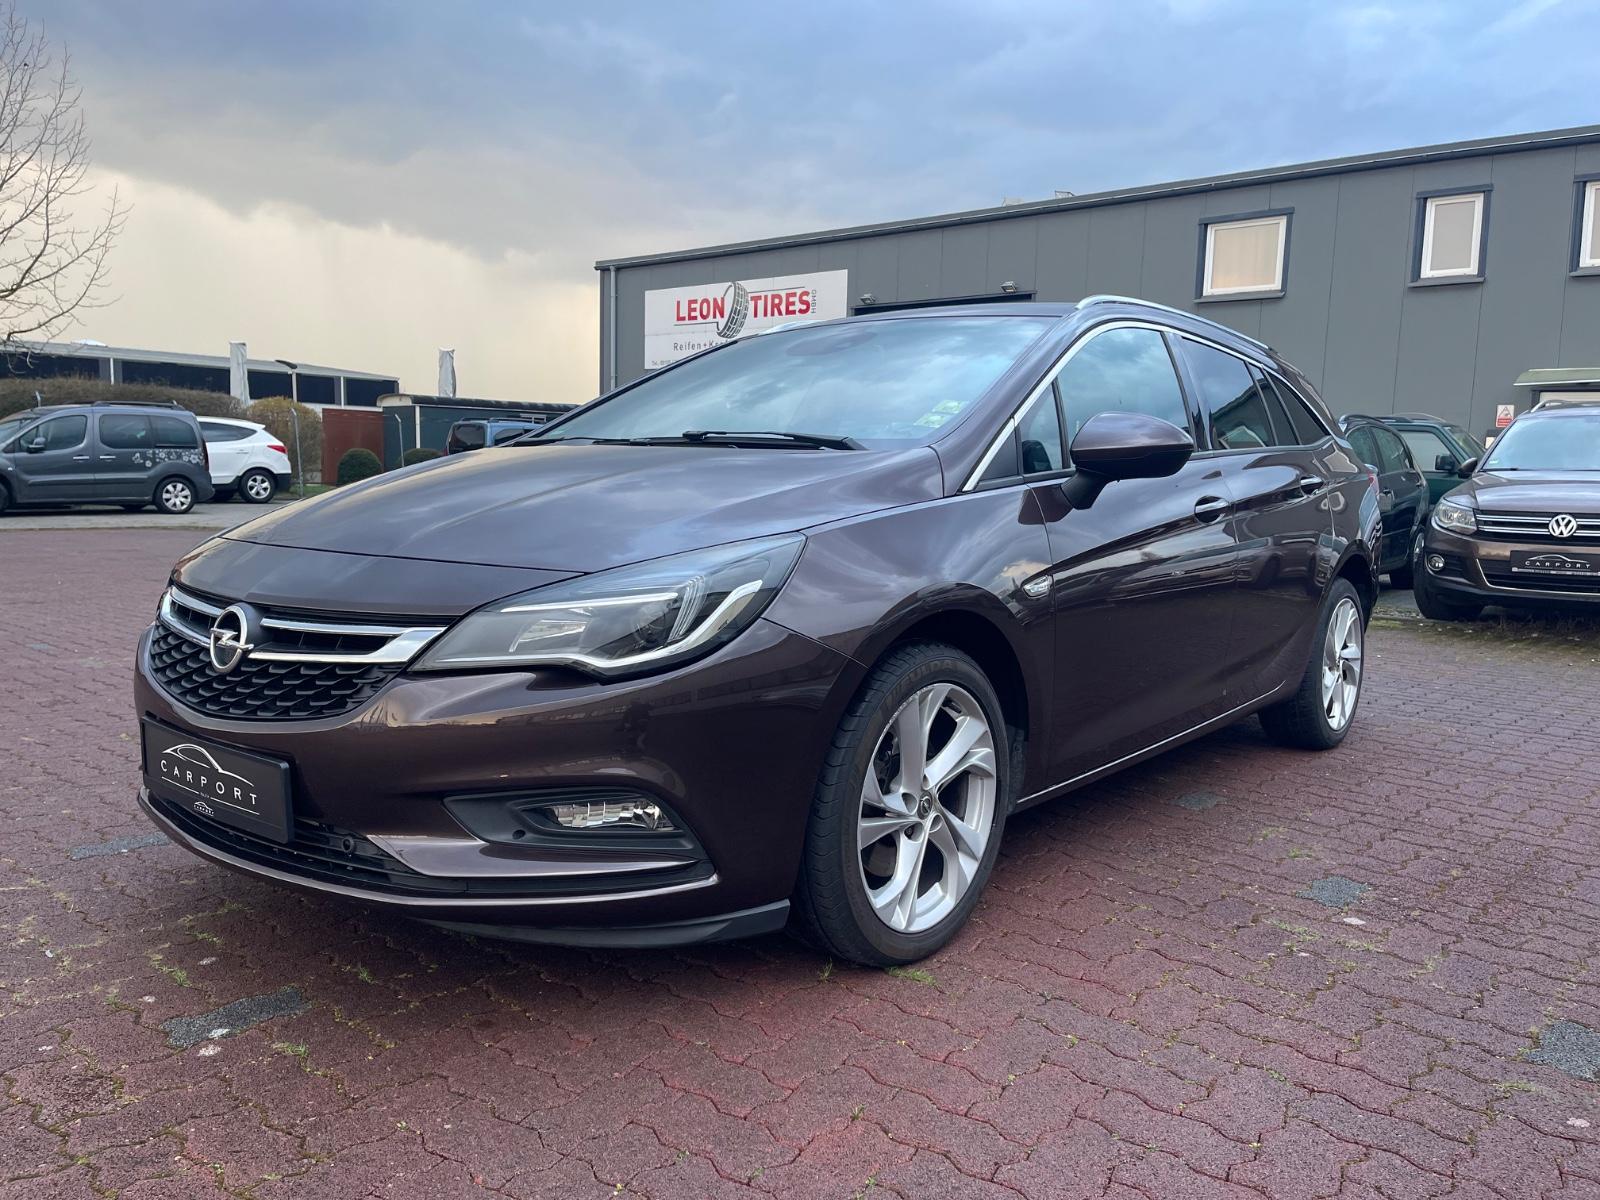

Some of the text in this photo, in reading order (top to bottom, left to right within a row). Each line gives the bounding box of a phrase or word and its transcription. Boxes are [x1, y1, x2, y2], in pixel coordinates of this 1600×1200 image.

[676, 291, 811, 321] LEON TIRES
[1549, 514, 1577, 537] VW
[1525, 560, 1590, 569] CARPORT
[160, 759, 258, 805] CARPORT
